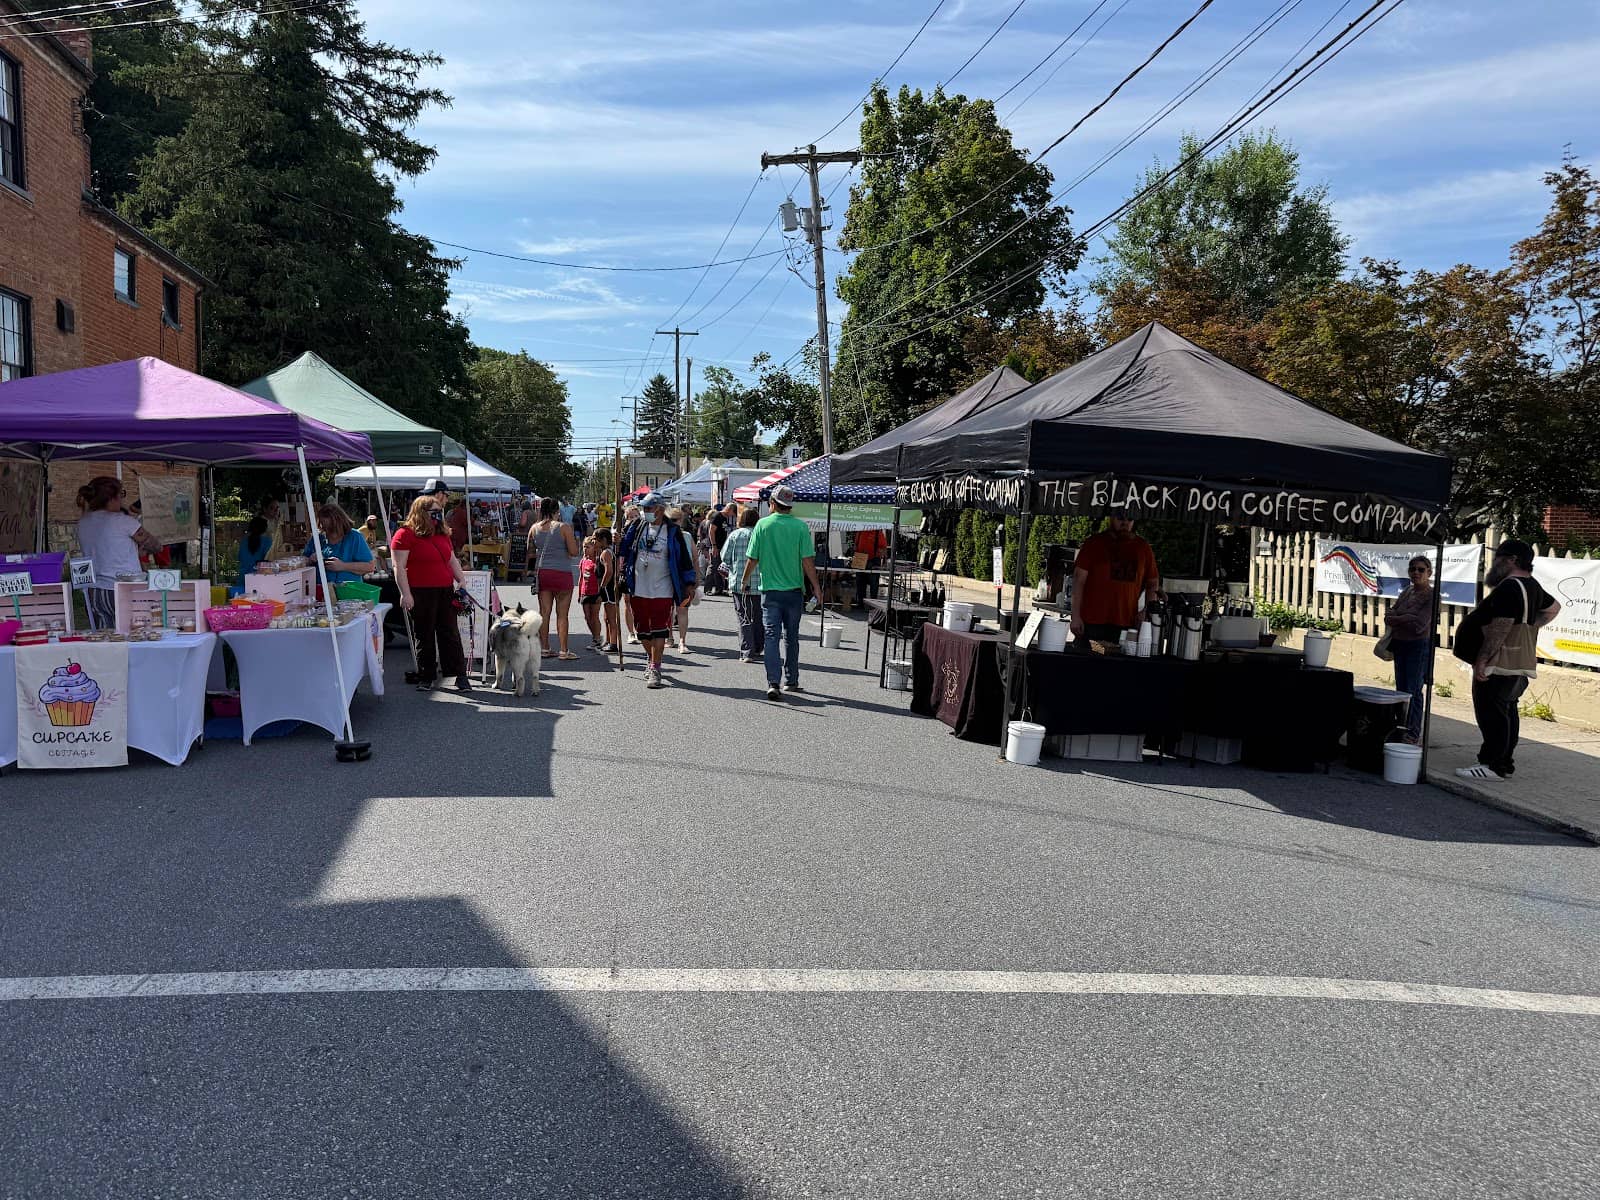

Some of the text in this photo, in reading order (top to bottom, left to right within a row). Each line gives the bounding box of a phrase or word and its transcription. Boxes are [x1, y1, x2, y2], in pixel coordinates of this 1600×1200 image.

[896, 475, 1023, 507] THE BLACK DOG COFFEE COMPAN
[843, 504, 858, 513] Edge
[1039, 480, 1441, 537] THE BLACK DOG COFFEE COMPANY
[806, 520, 857, 532] HARENING
[0, 578, 26, 587] SUGAR
[1, 585, 26, 594] FREE
[1557, 576, 1598, 615] Sunny
[1560, 627, 1590, 637] BRIGHTER
[32, 731, 113, 743] CUPCAKE
[48, 749, 96, 758] COTTAGE
